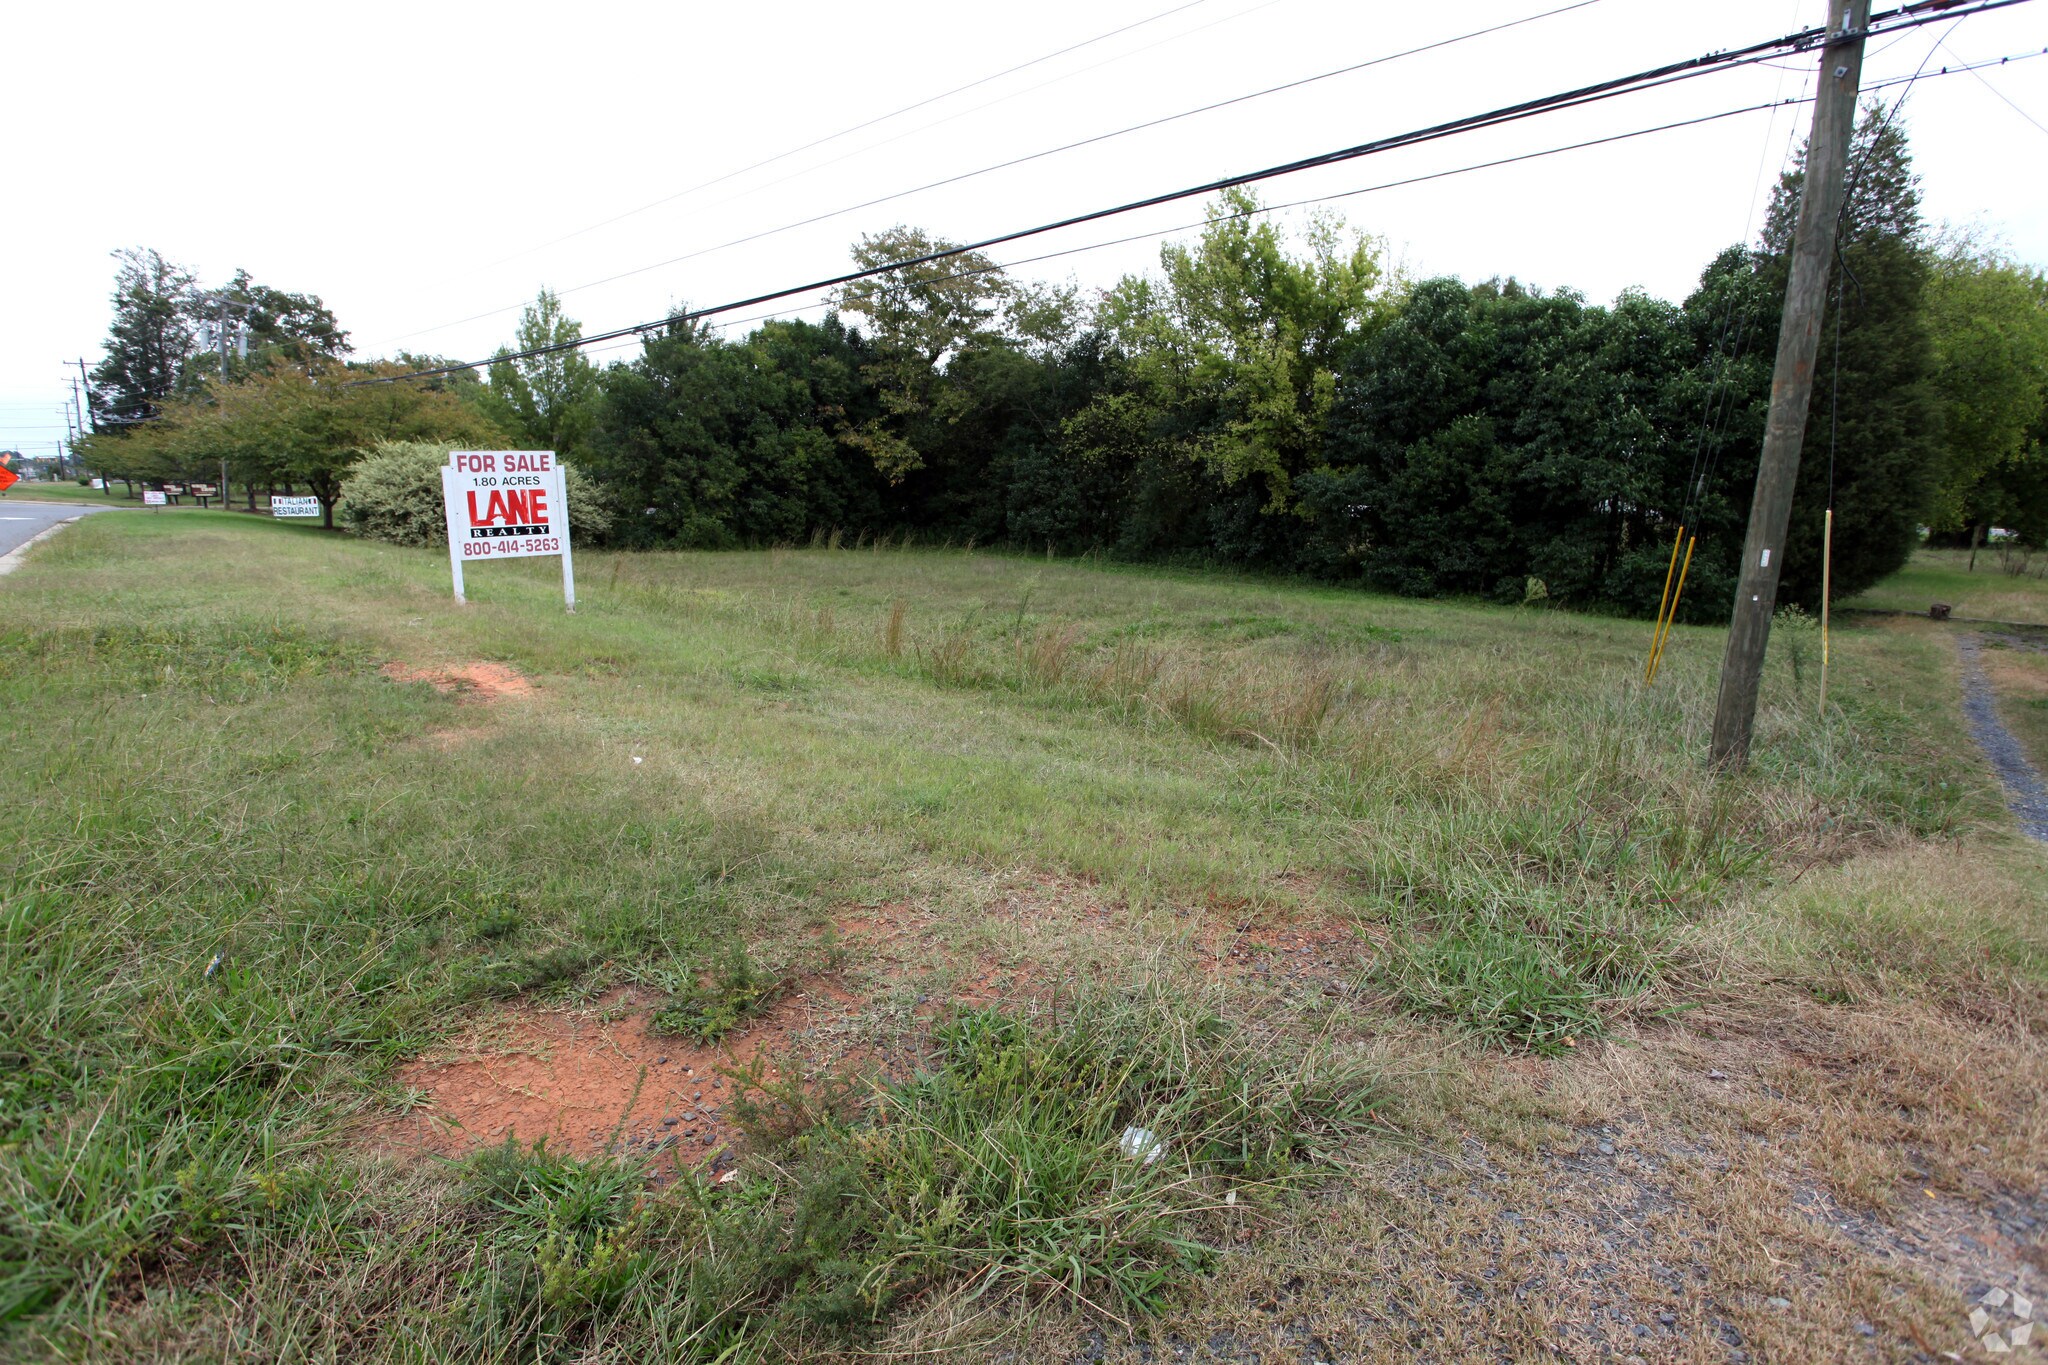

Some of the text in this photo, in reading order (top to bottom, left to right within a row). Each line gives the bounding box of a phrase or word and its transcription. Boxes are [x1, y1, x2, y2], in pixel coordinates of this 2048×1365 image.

[457, 455, 550, 472] FOR SALE
[473, 476, 540, 487] 1.80 ACRES
[273, 506, 318, 515] RESTAURANT
[467, 489, 549, 527] LANE
[473, 526, 547, 537] REALTY
[464, 538, 559, 556] 800-414-5263
